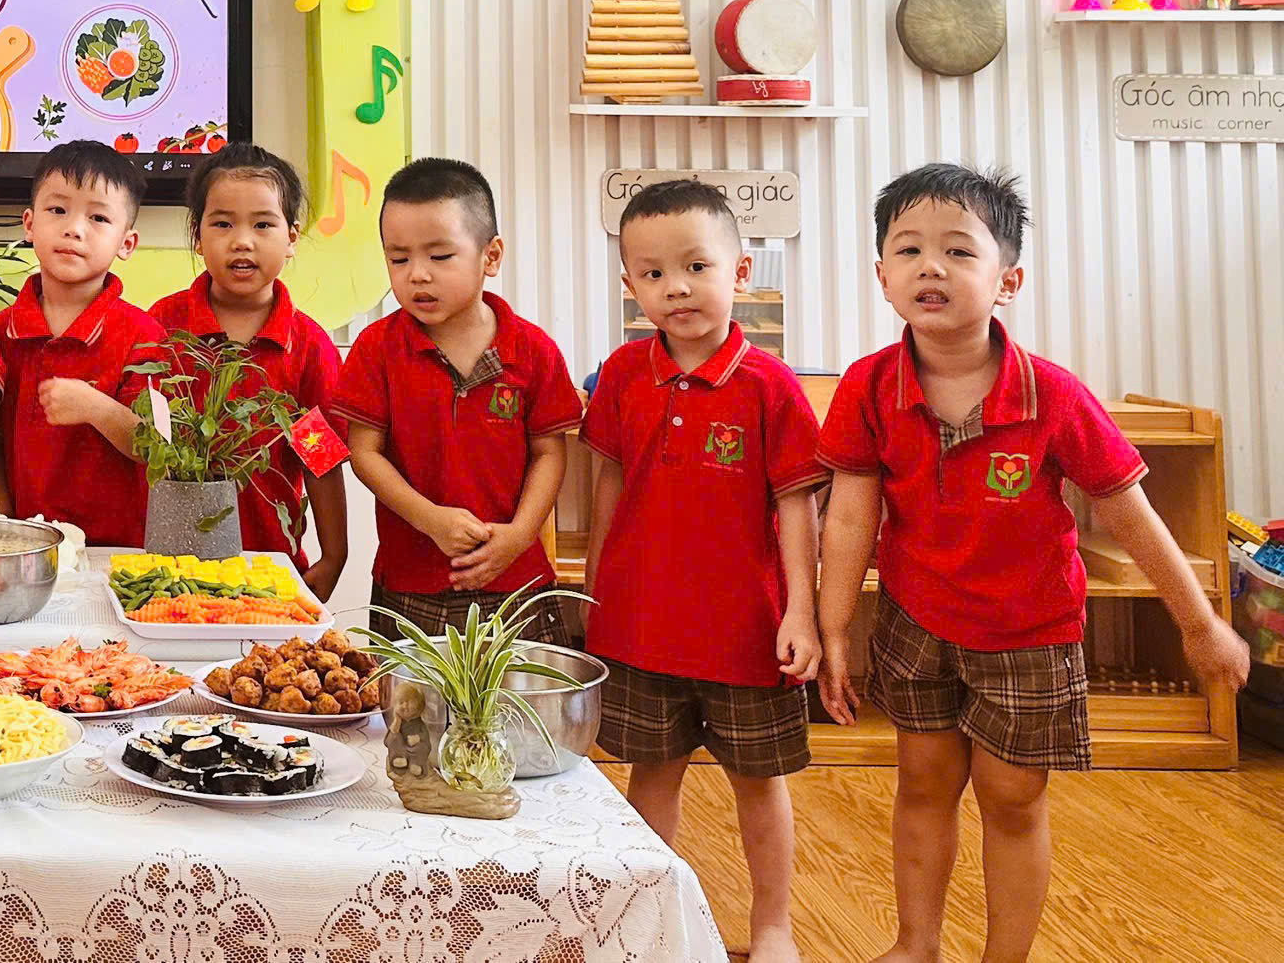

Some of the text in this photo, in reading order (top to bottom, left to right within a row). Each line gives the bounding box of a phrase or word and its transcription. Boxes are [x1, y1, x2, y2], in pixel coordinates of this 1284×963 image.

[1120, 78, 1176, 107] Góc
[1188, 84, 1230, 107] âm
[1152, 117, 1274, 130] music corner
[606, 172, 643, 199] Gó
[736, 175, 794, 211] giác
